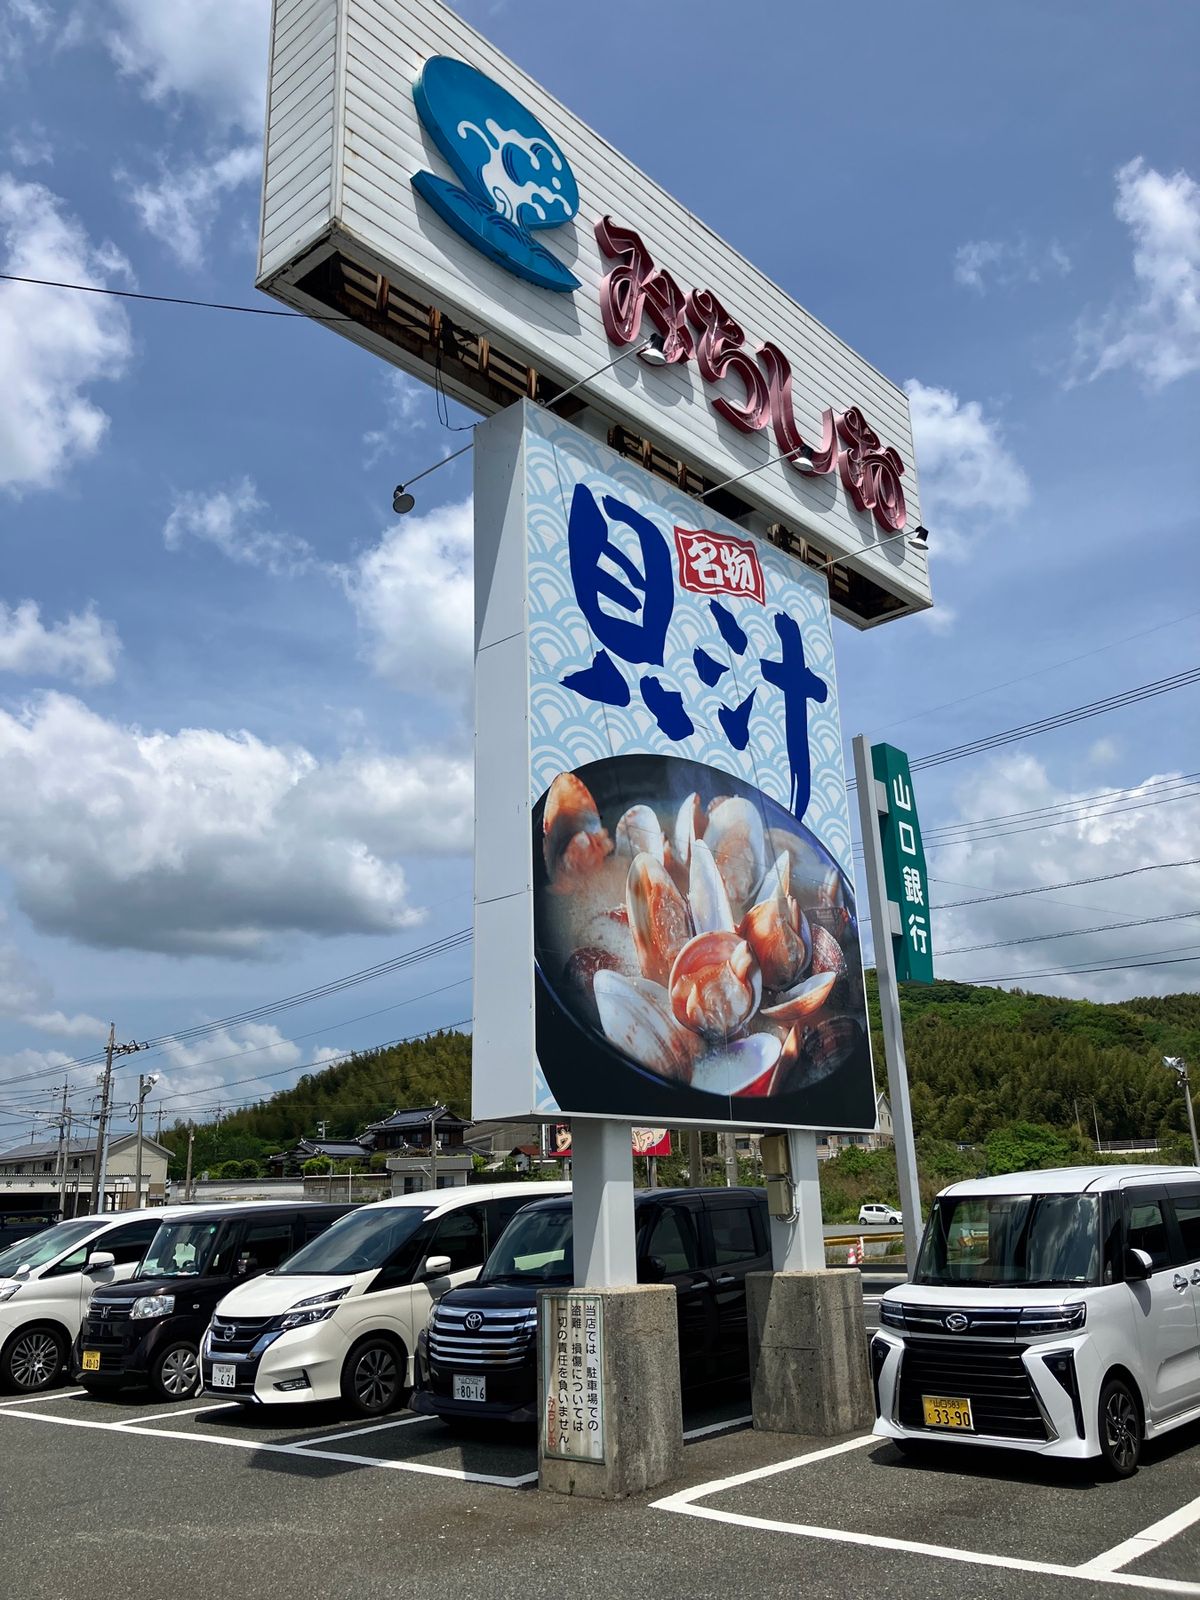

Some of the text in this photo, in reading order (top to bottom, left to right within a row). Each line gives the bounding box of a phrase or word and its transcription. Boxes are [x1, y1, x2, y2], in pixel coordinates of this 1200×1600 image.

[594, 214, 906, 533] みちしお
[687, 535, 756, 592] 名物
[558, 482, 829, 822] 貝汁
[892, 773, 928, 955] 山口銀行
[571, 1305, 584, 1432] 盗難・損傷については
[585, 1305, 599, 1432] 当店では、駐車場での
[934, 1408, 971, 1427] 33-90
